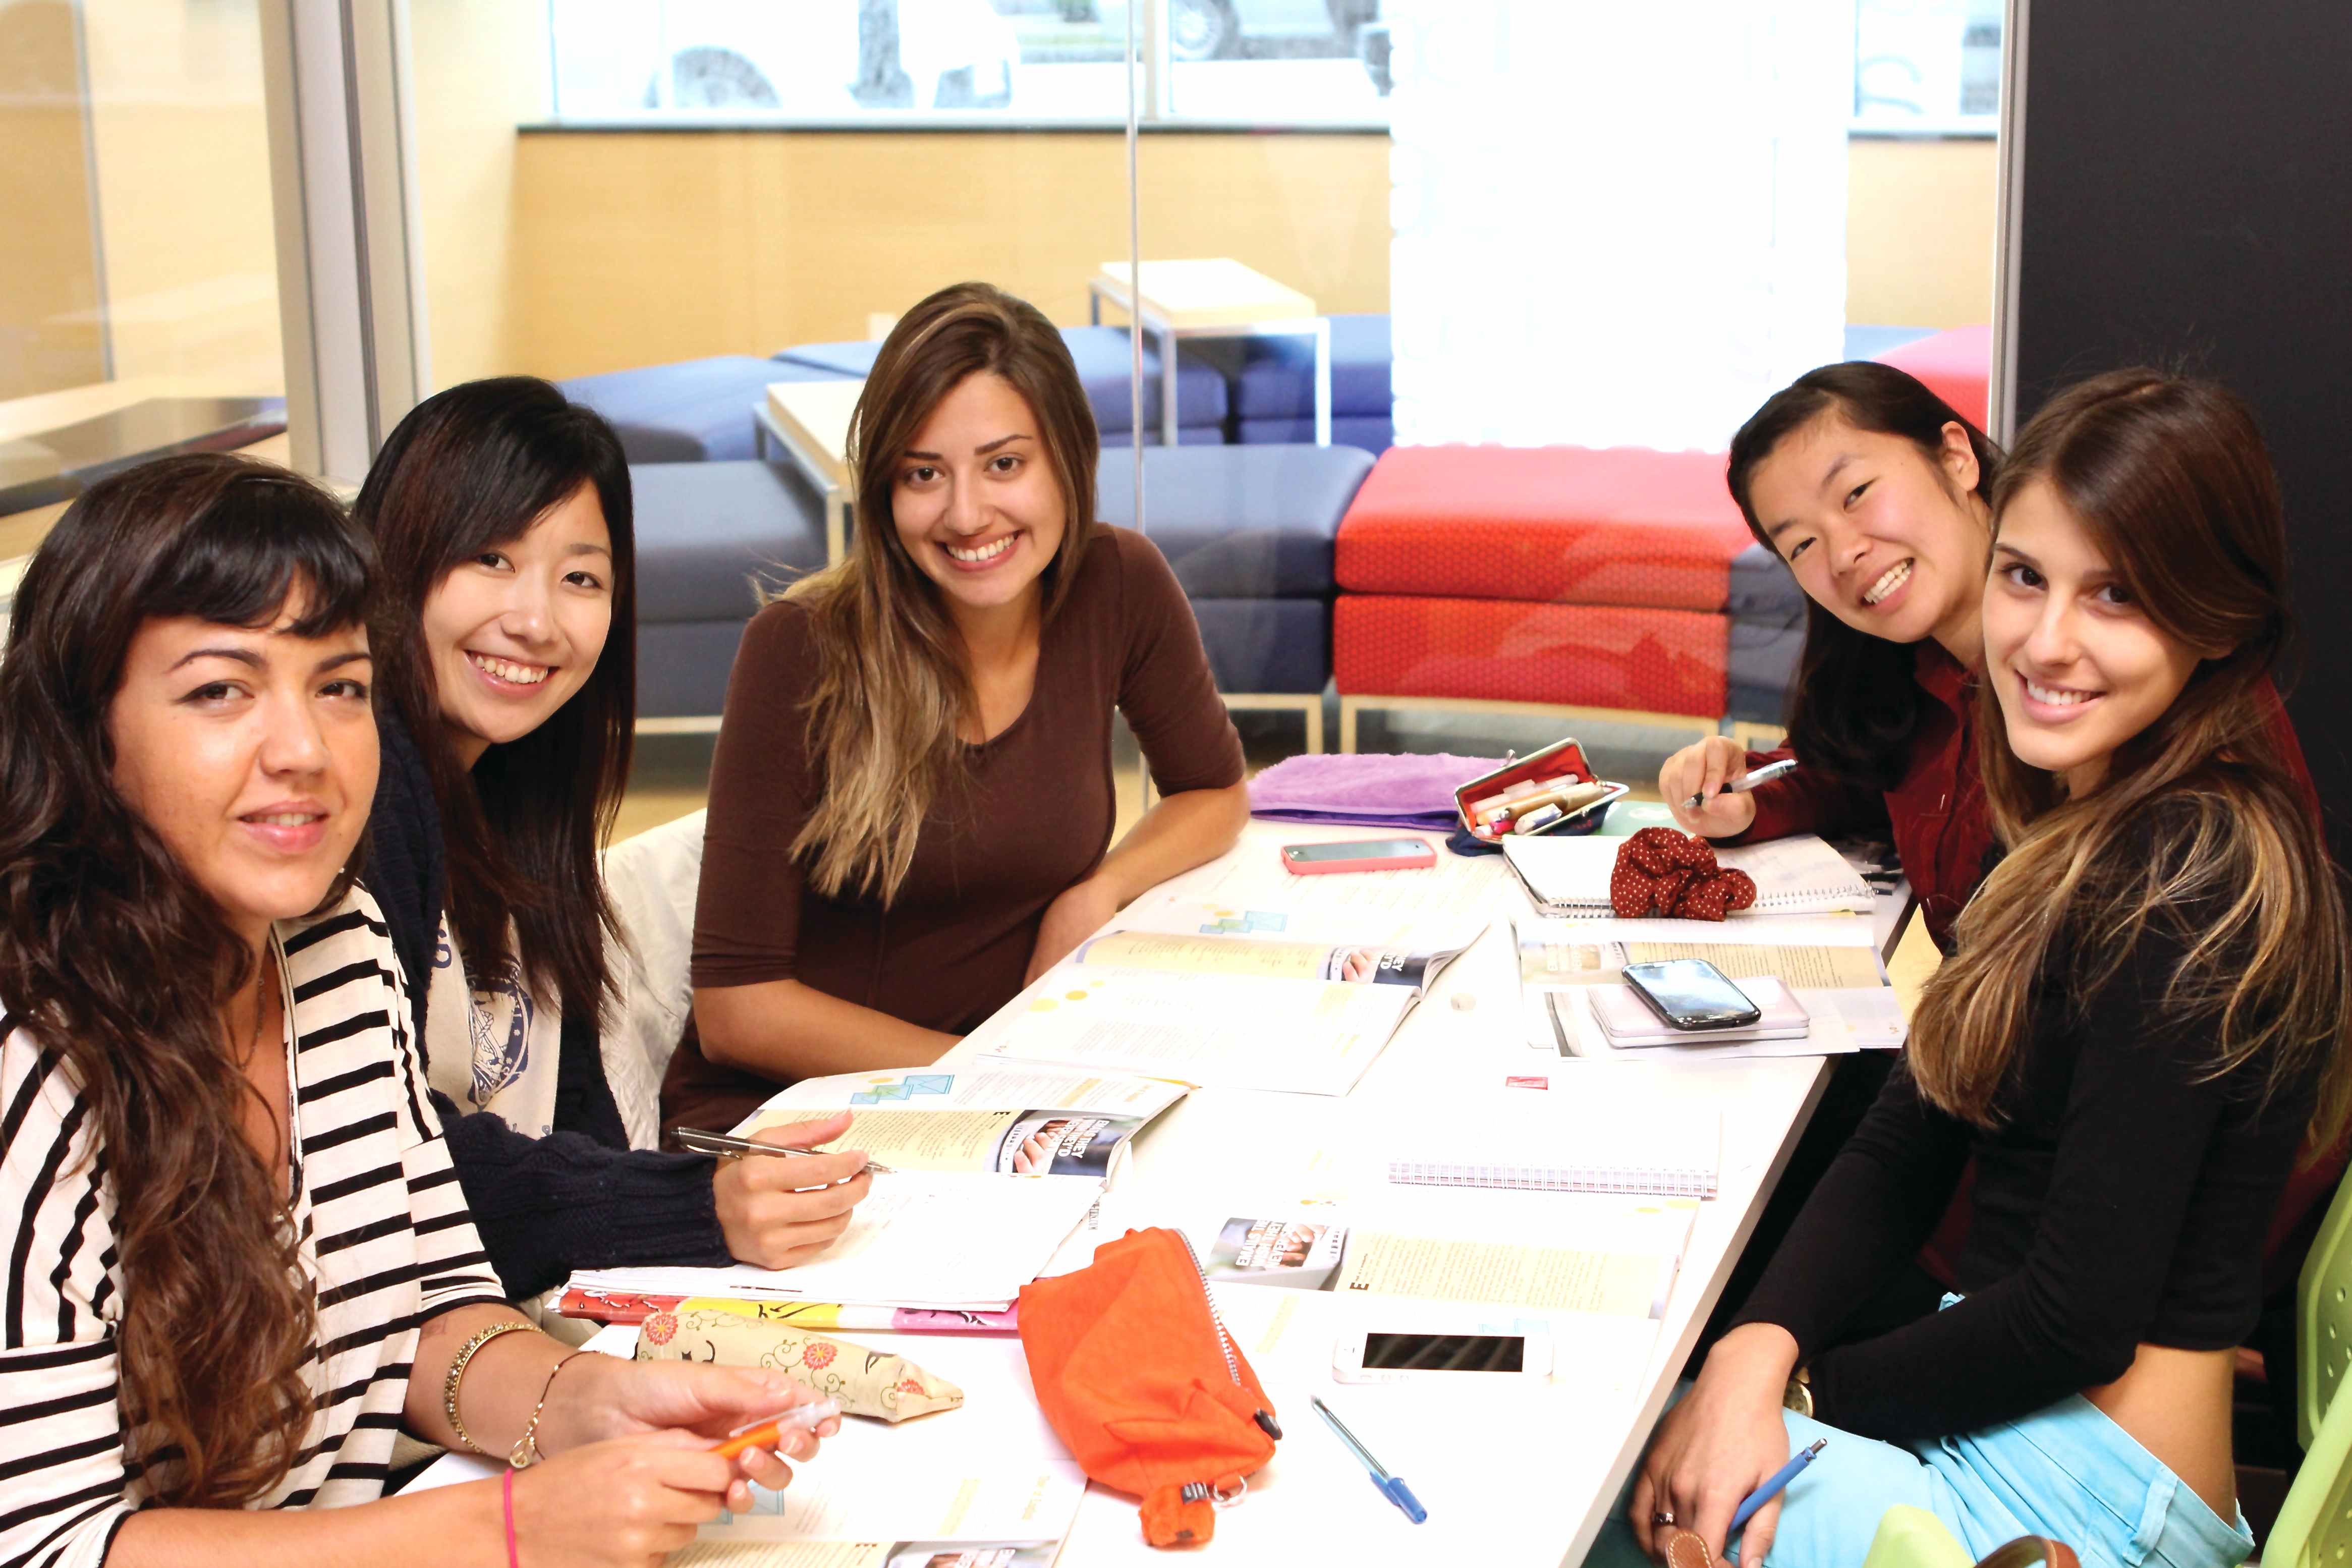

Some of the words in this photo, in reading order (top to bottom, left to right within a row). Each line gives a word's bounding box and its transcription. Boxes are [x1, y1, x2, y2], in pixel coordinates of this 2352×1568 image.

[1058, 1132, 1084, 1157] THEY'D
[1071, 1137, 1092, 1158] THEY
[1236, 1233, 1262, 1266] EMAILS
